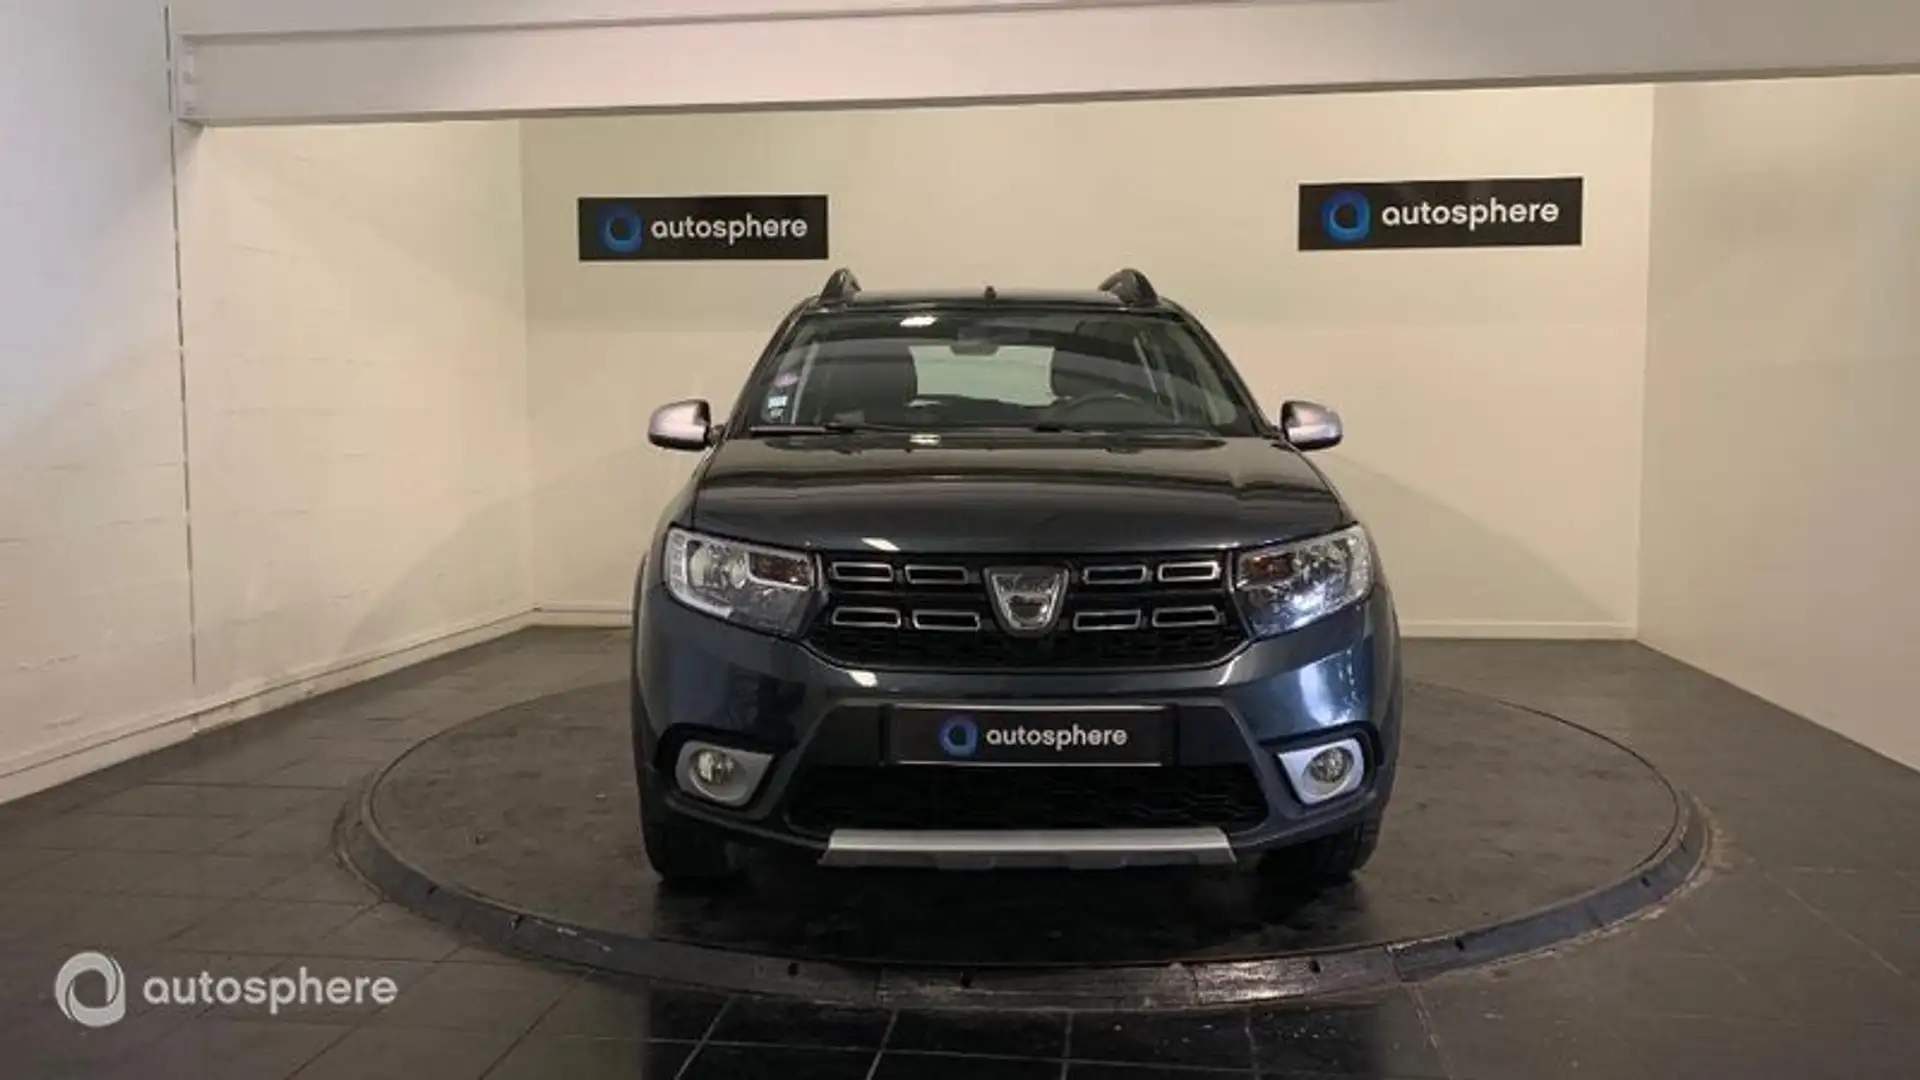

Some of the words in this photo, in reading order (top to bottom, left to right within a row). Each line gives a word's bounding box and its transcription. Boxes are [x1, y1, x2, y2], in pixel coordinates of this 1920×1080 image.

[650, 213, 809, 246] autosphere
[1381, 196, 1560, 232] autosphere
[985, 723, 1127, 751] autosphere
